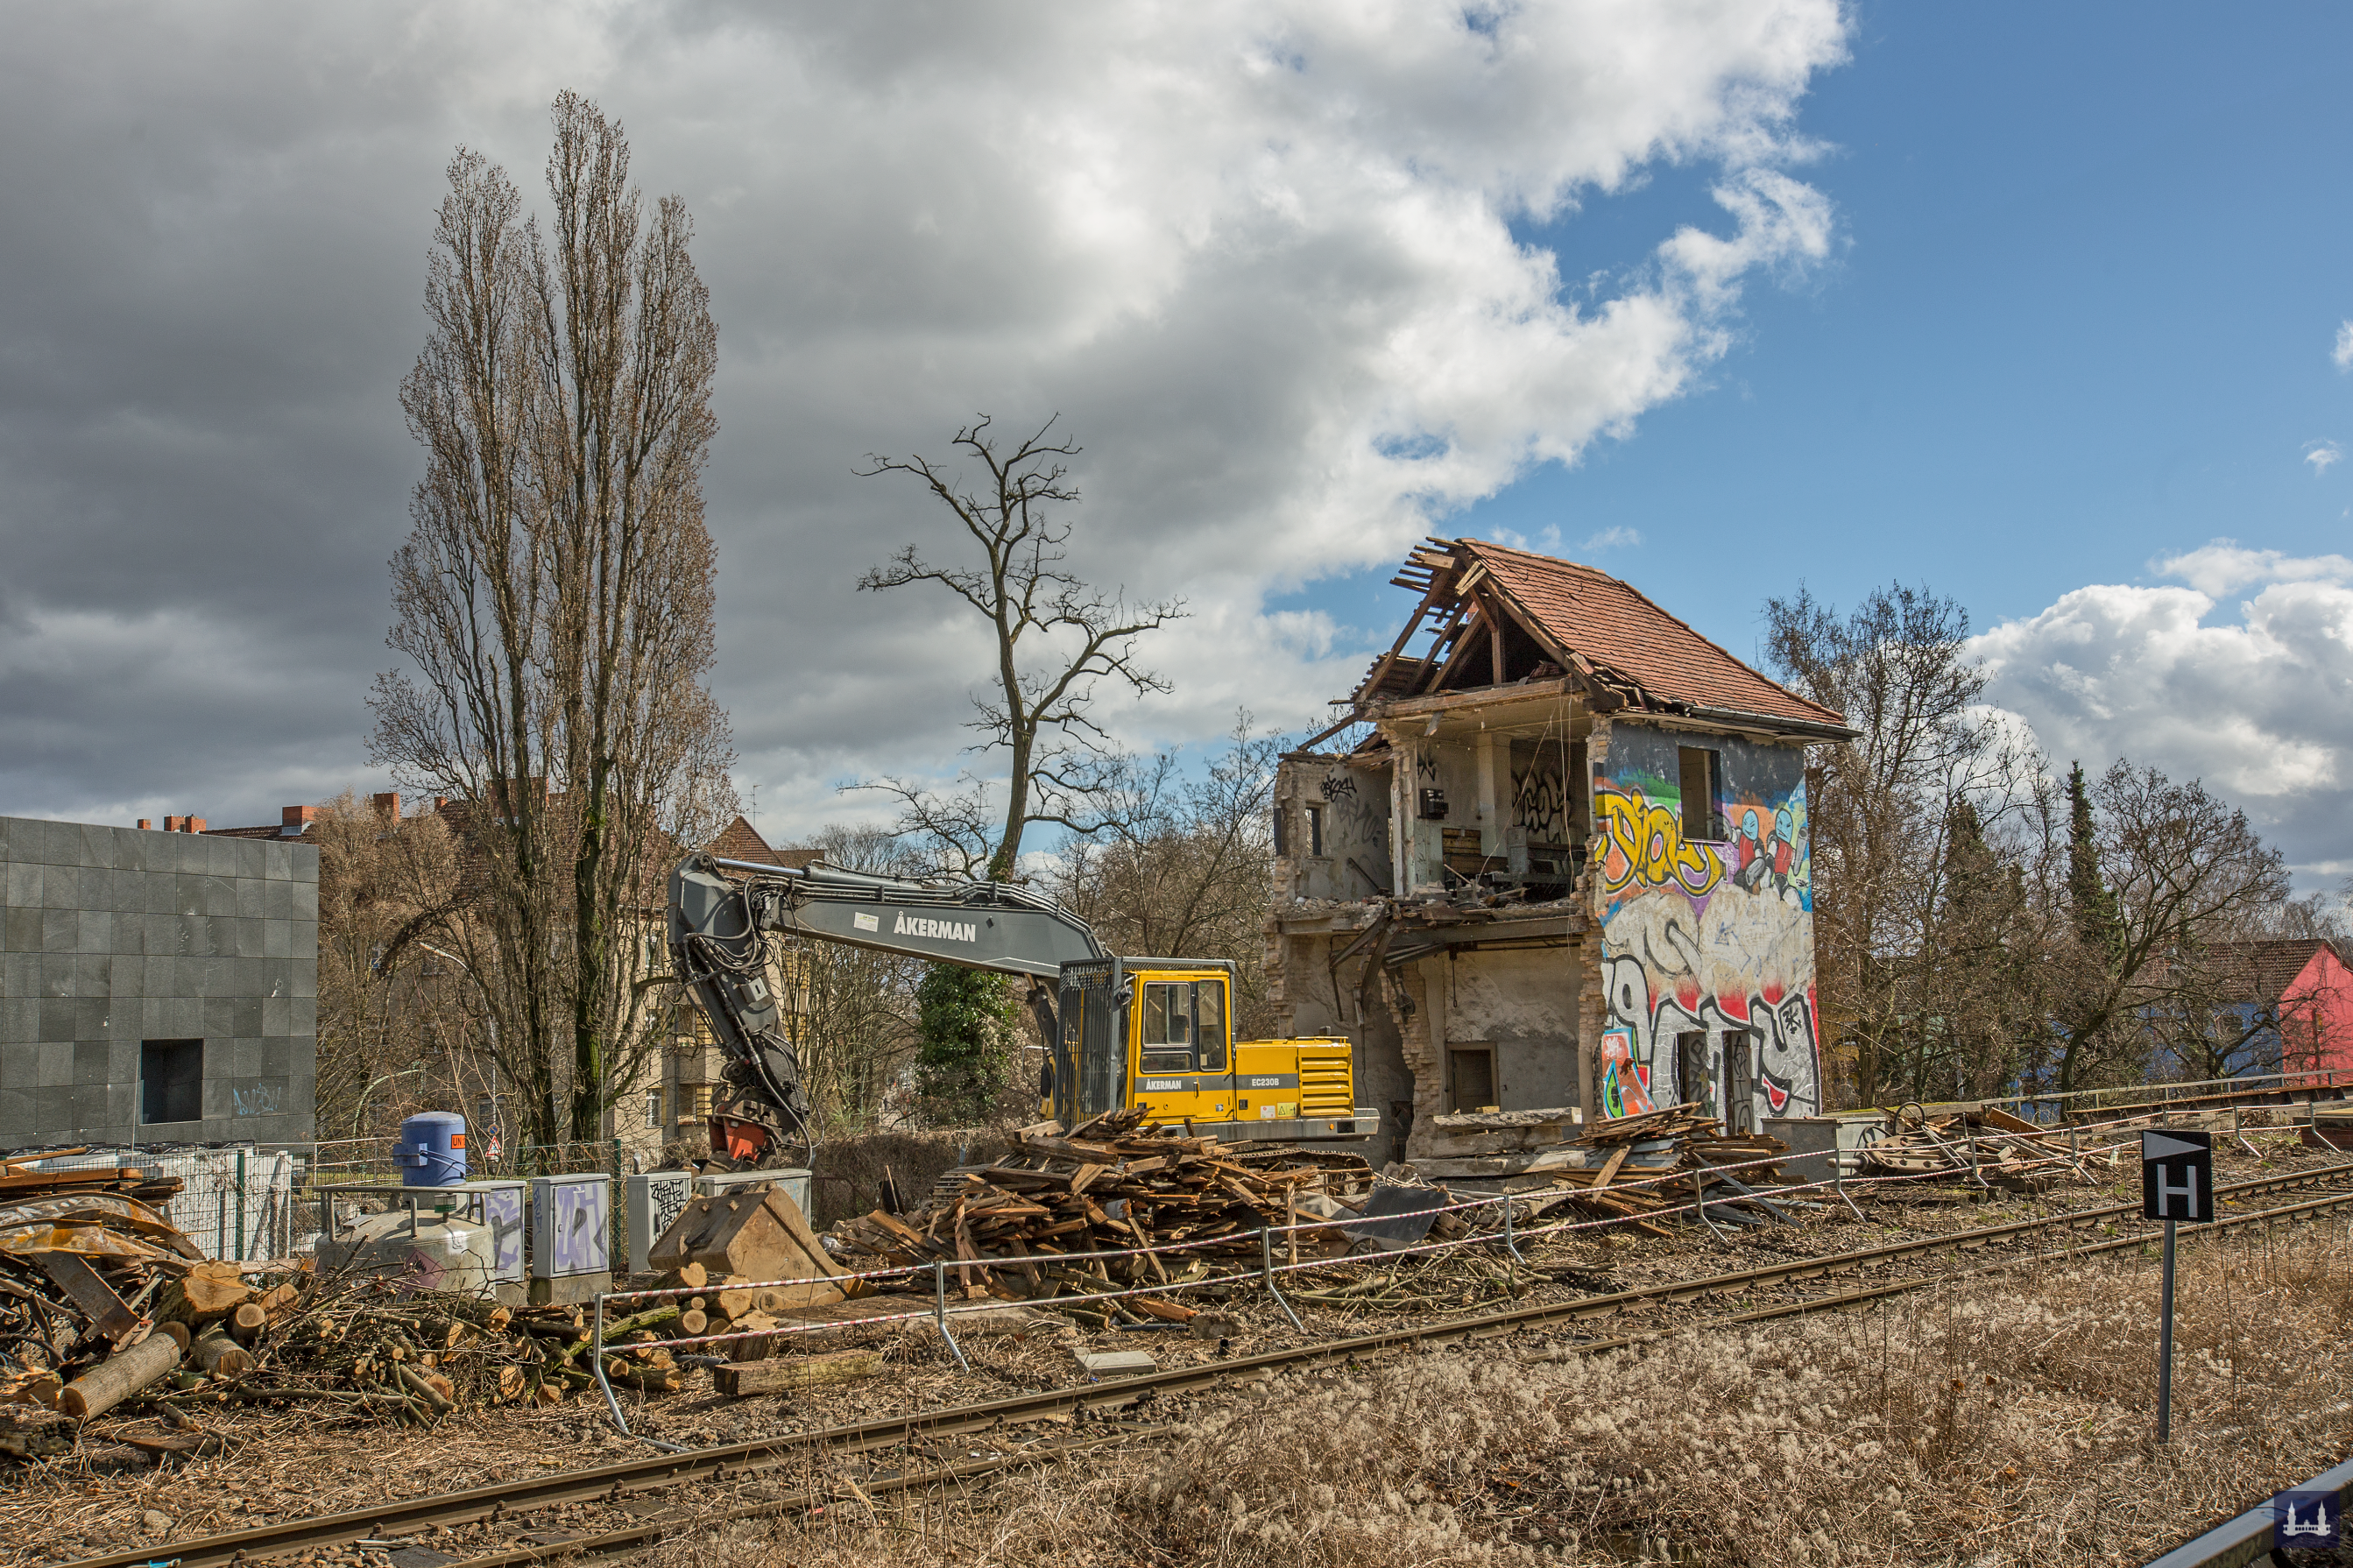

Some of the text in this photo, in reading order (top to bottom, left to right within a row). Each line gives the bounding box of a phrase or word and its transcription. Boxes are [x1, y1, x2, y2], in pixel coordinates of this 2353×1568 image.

[894, 910, 976, 942] ÅKERMAN
[1146, 1078, 1182, 1091] ÅKERMAN
[1251, 1078, 1280, 1087] EC230B
[453, 1137, 462, 1147] UN
[2157, 1163, 2198, 1218] H
